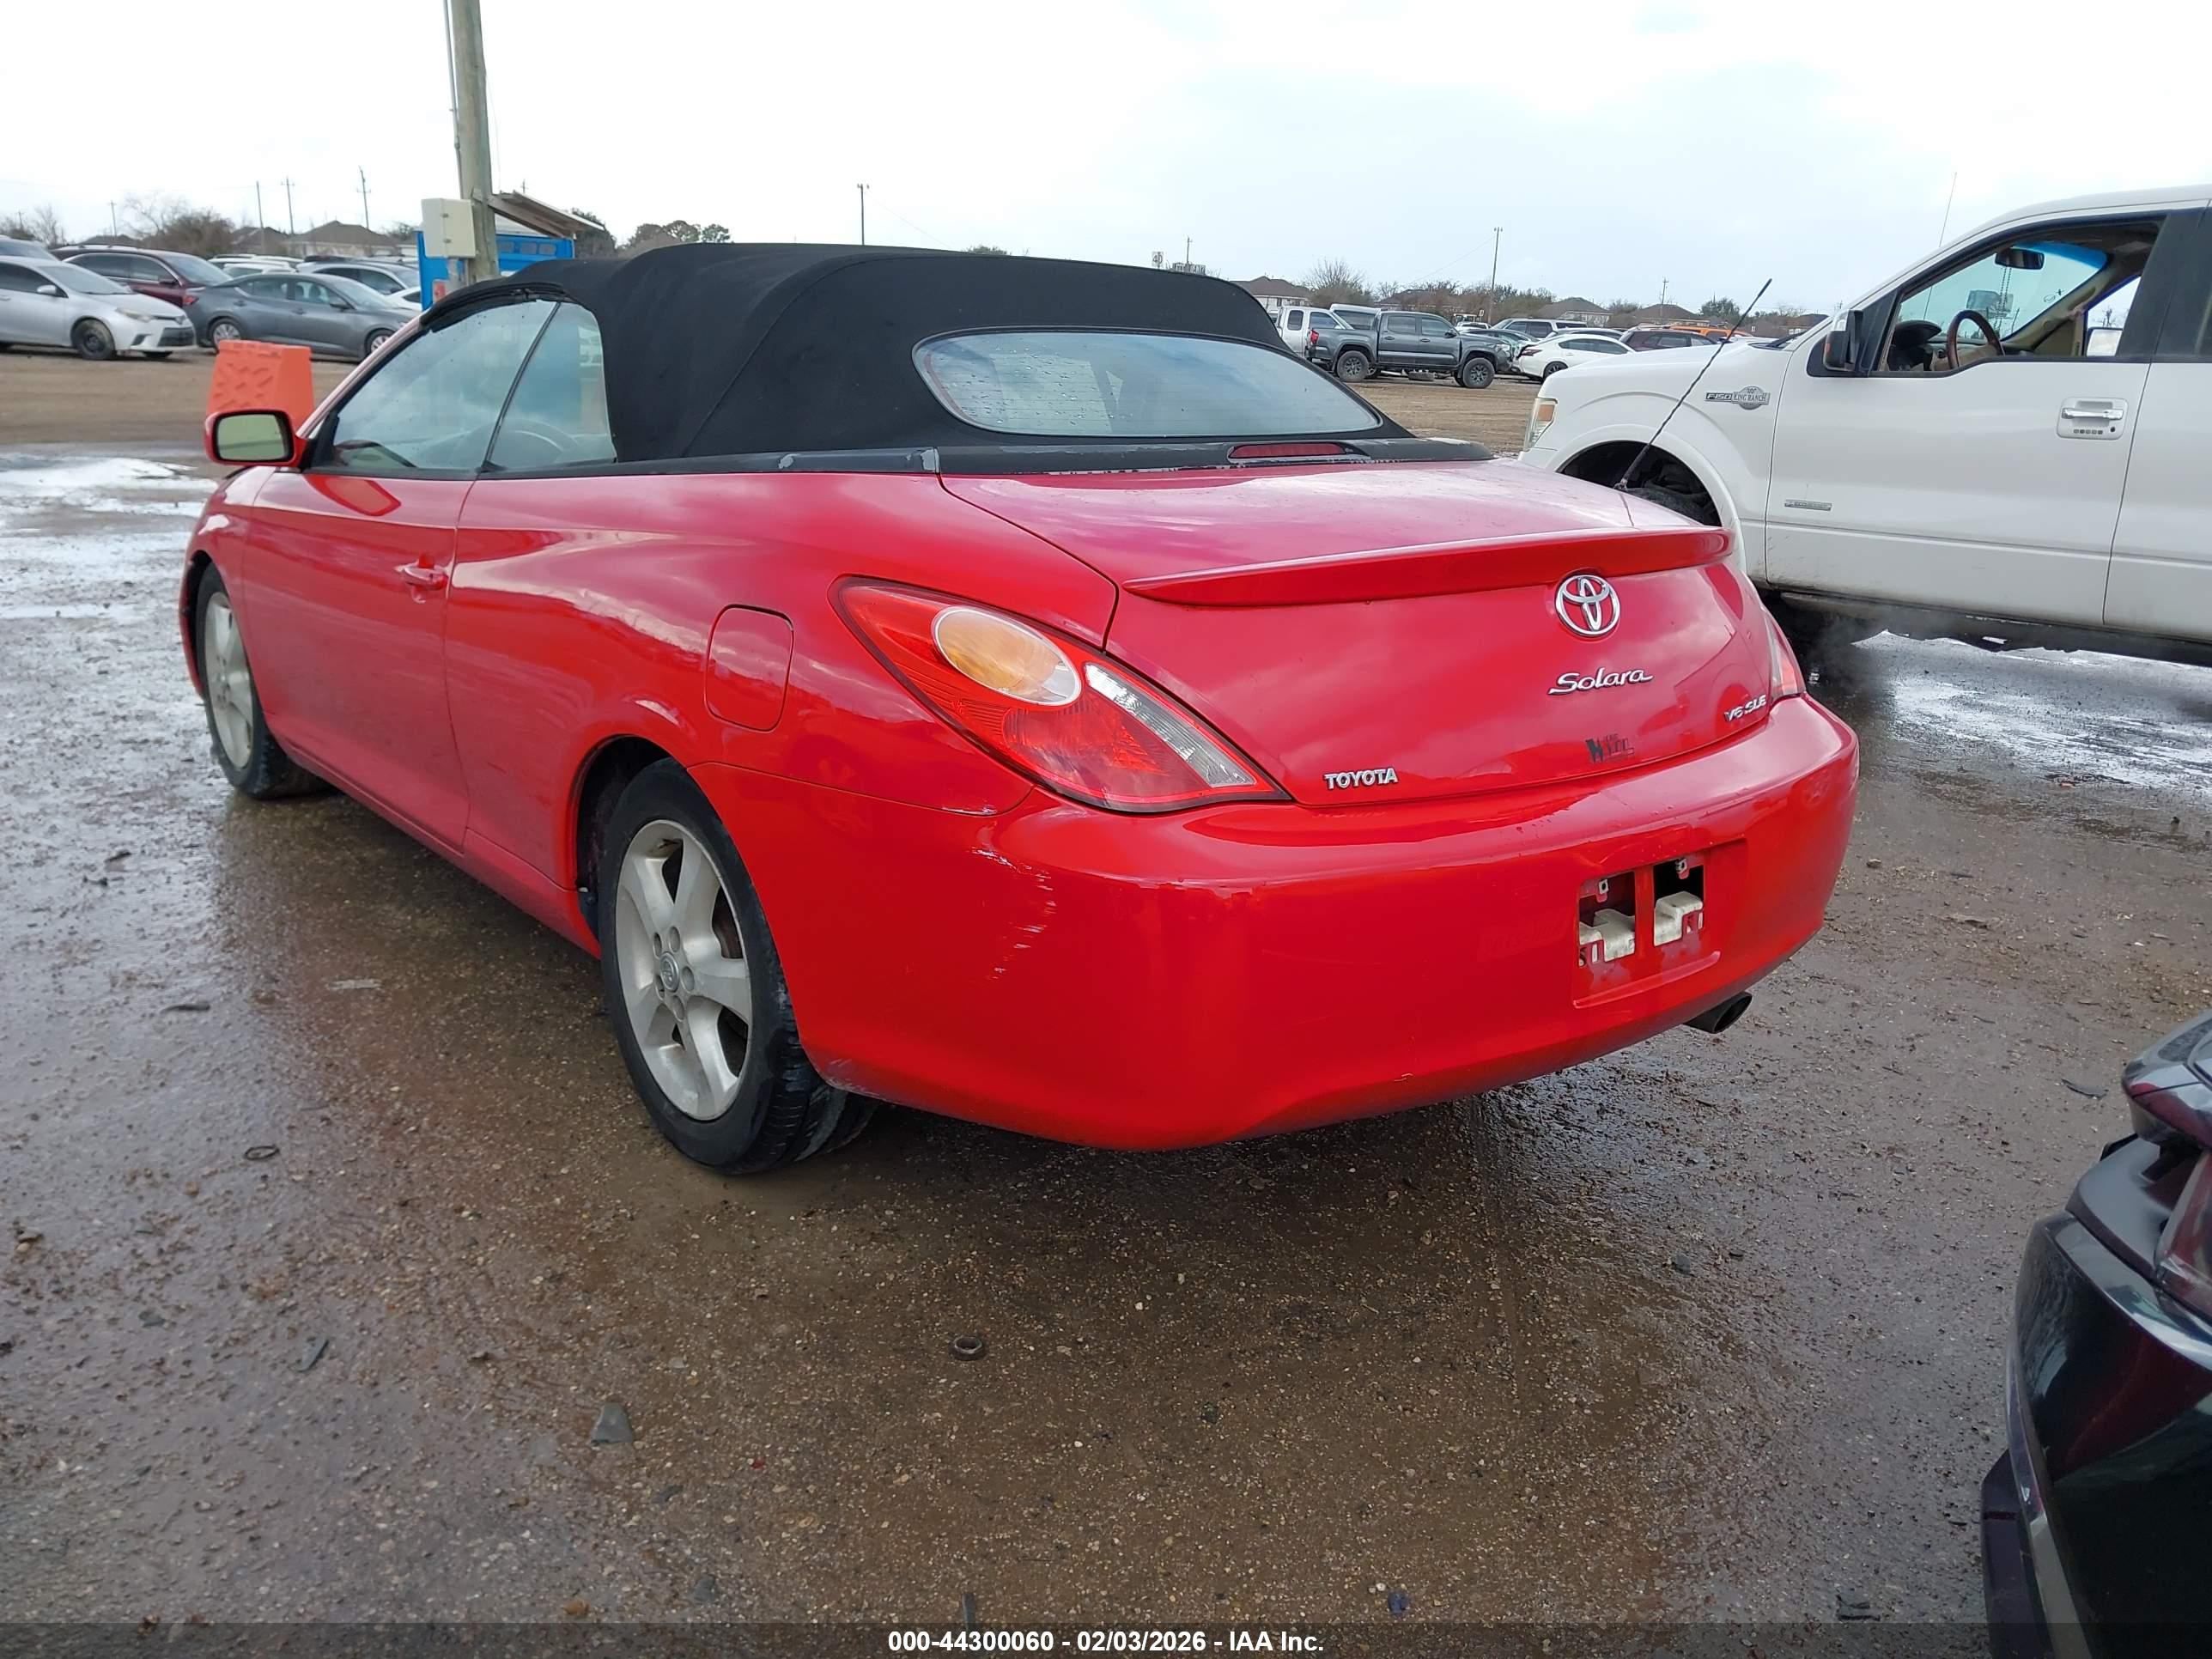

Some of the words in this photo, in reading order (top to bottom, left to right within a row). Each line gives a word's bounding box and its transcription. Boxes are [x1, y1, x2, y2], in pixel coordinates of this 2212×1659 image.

[1547, 667, 1654, 696] Solara
[1723, 705, 1744, 721] V6
[1744, 694, 1767, 714] SLE
[1323, 768, 1399, 790] TOYOTA
